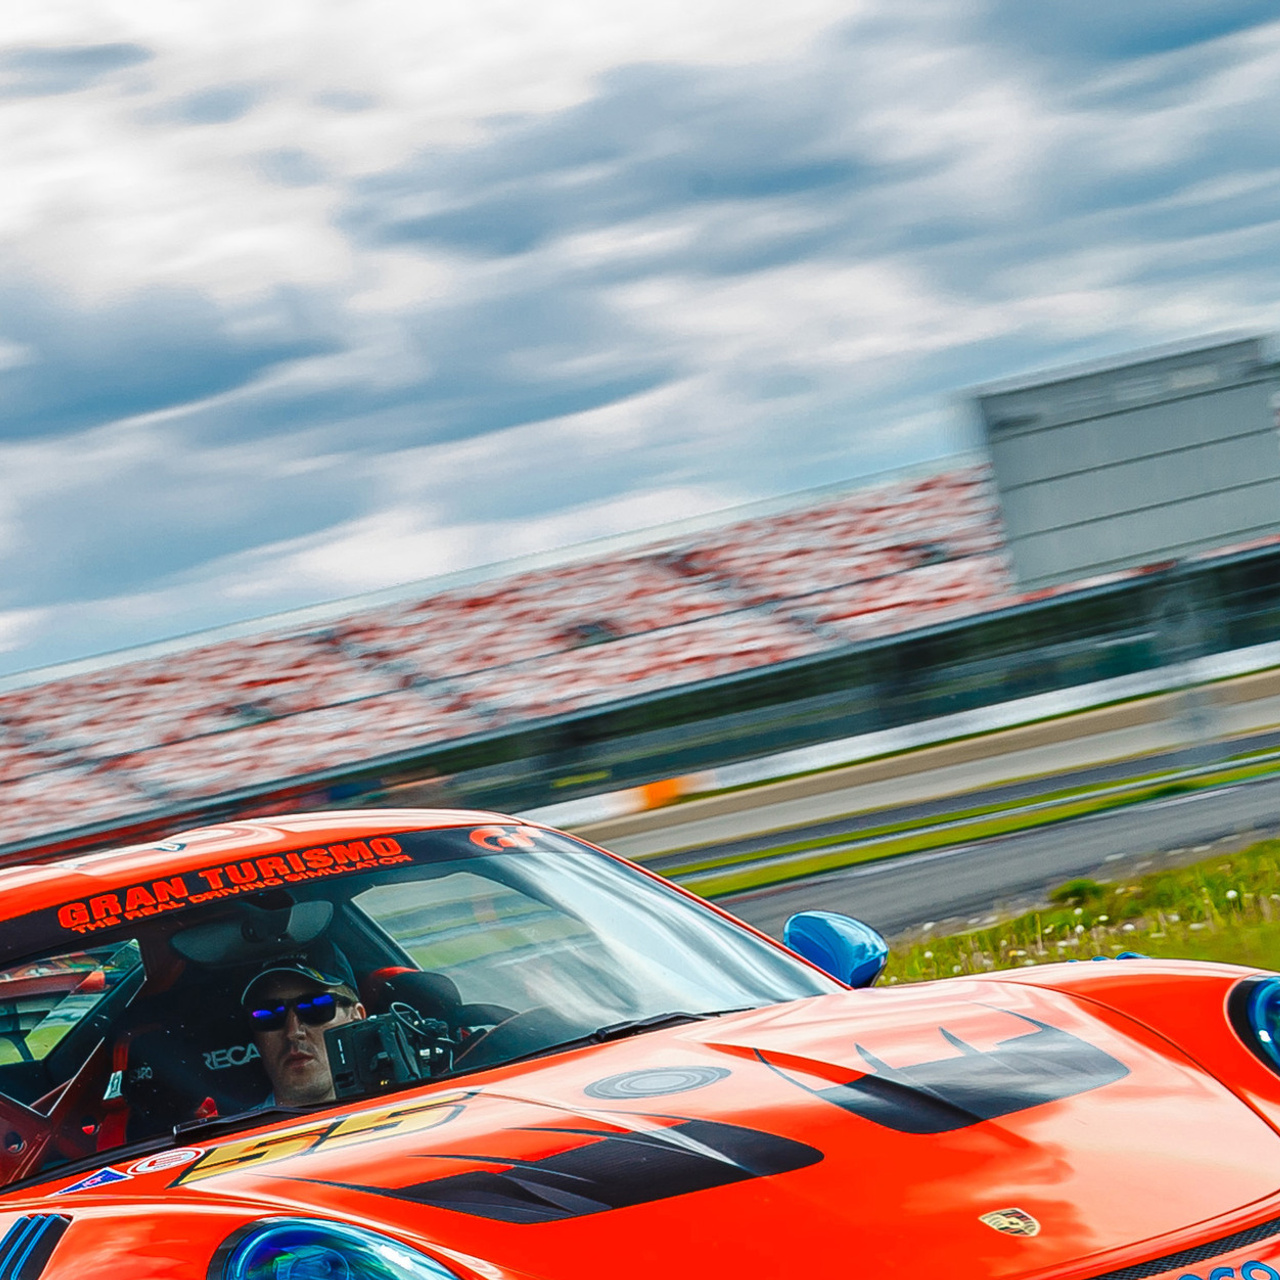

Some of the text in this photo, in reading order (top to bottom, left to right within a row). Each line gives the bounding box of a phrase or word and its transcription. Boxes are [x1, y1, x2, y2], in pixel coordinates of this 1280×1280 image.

[57, 837, 402, 930] GRAN TURISMO
[71, 853, 413, 934] THE REAL DRIVING SIMULATOR
[202, 1043, 262, 1070] RECA
[166, 1088, 484, 1188] 55
